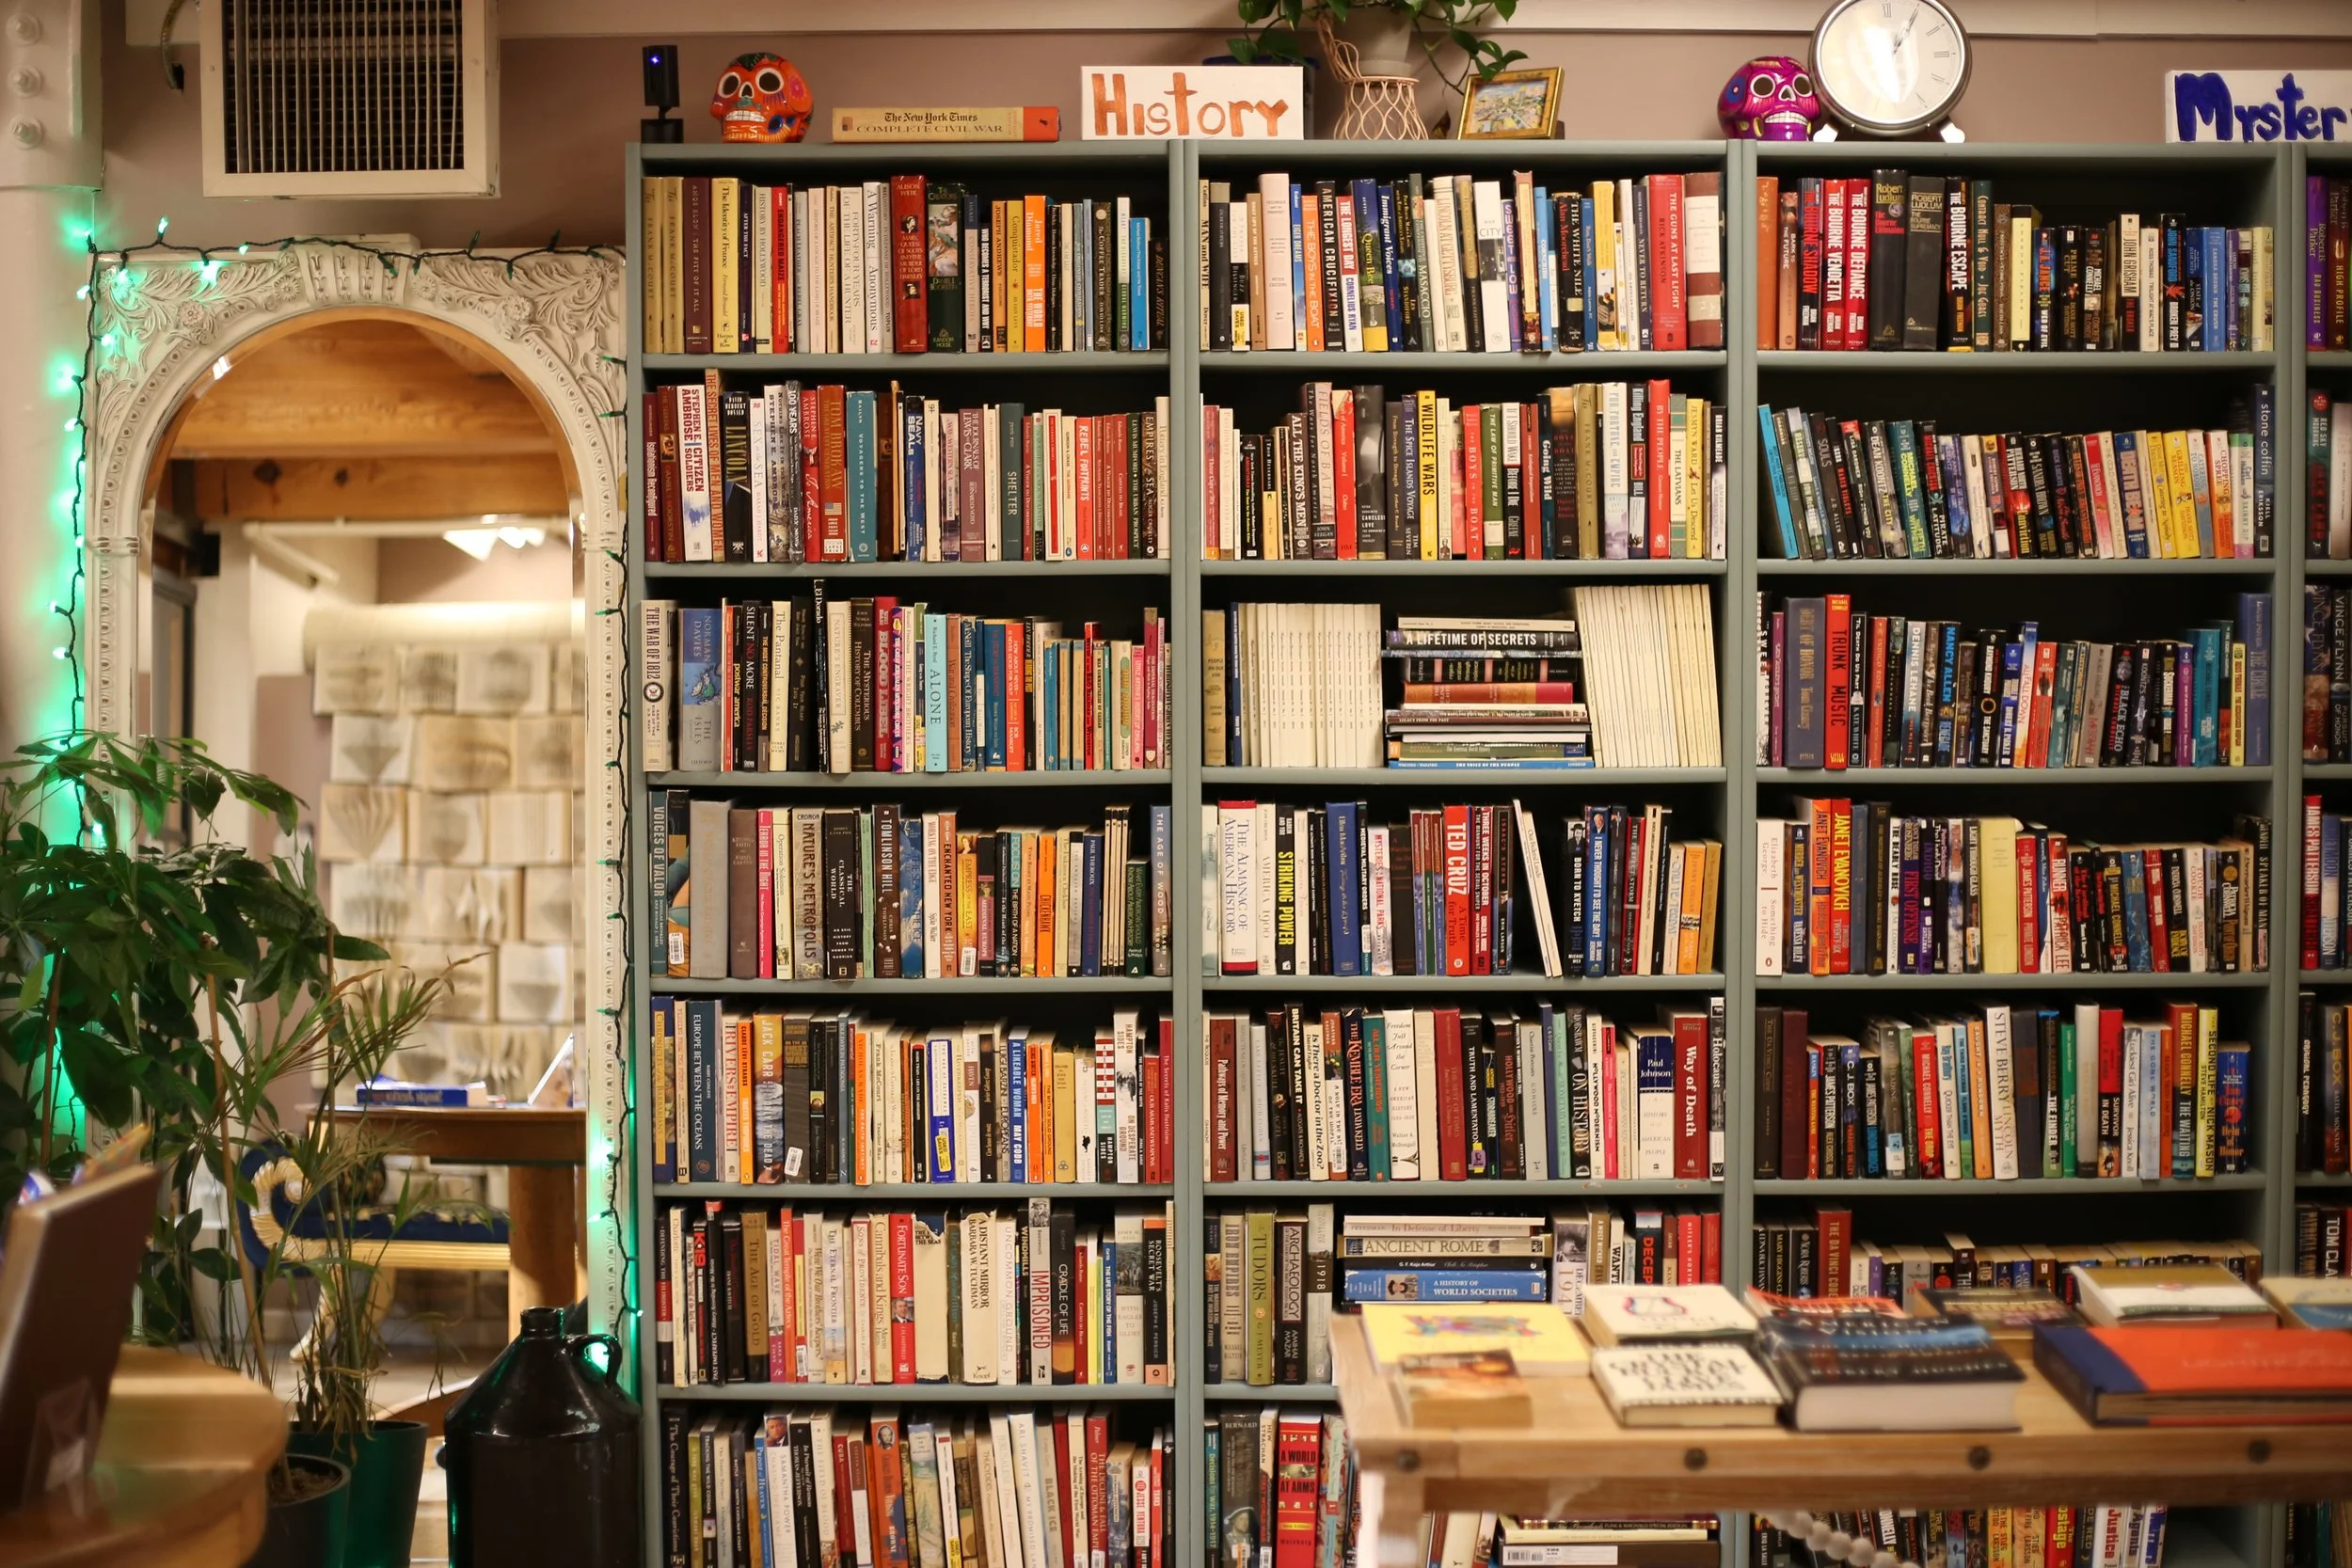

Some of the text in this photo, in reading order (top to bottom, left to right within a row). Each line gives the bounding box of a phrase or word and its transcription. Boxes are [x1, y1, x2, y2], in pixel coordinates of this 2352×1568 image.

[857, 125, 932, 134] COMPLETE
[934, 125, 971, 134] CIVIL
[884, 112, 977, 125] The New York Times
[2175, 72, 2352, 143] Myster
[1322, 188, 1339, 317] AMERICAN CRUCIFIXION
[1340, 201, 1355, 270] THE LONGEST DAY
[1380, 195, 1393, 275] Immigrant Voices
[1436, 198, 1456, 295] LINCOLN AT GETTYSBURG
[1570, 202, 1582, 296] THE WHITE NILE
[1671, 242, 1678, 255] AT
[1671, 256, 1679, 278] LAST
[1827, 192, 1844, 302] THE BOURNE VENDETTA
[1850, 193, 1867, 300] THE BOURNE DEFIANCE
[1949, 192, 1968, 291] THE BOURNE ESCAPE
[2123, 238, 2137, 293] JOHN GRISHAM
[1419, 264, 1431, 319] MASACCIO
[1672, 280, 1680, 309] LIGHT
[682, 388, 692, 441] AMBROSE
[691, 388, 702, 434] STEPHEN
[2260, 404, 2272, 476] stone coffin
[685, 448, 694, 493] SOLDIERS
[693, 447, 705, 492] CITIZEN
[706, 374, 724, 551] THE SECRET LIVES OF MEN AND WOMEN
[725, 426, 748, 483] LINCOLN
[1079, 425, 1090, 501] REBEL FOOTPRINTS
[1406, 419, 1417, 520] THE SPICE ISLANDS VOYAGE
[1421, 404, 1435, 496] WILDLIFE WARS
[1007, 470, 1018, 515] SHELTER
[646, 608, 660, 680] THE WAR OF 1812
[745, 606, 755, 689] SILENT NO MORE
[1406, 634, 1537, 646] A LIFETIME OF SECRETS
[1908, 626, 1920, 713] DENNIS LEHANE
[1942, 626, 1956, 703] NANCY ALLEN
[930, 670, 942, 725] ALONE
[1831, 628, 1848, 727] TRUNK MUSIC
[653, 806, 665, 897] VOICES OF VALOR
[881, 818, 893, 894] TOMLINSON HILL
[1225, 816, 1238, 935] AMERICAN HISTORY
[1238, 819, 1250, 931] THE ALMANAC OF
[1447, 822, 1468, 895] TED CRUZ
[1833, 813, 1851, 911] JANET EVANOVICH
[2053, 858, 2067, 893] RUNNER
[803, 823, 818, 958] NATURE'S METROPOLIS
[1279, 850, 1295, 945] STRIKING POWER
[2055, 916, 2070, 970] PATRICK LEE
[692, 1014, 702, 1049] EUROPE
[1291, 1008, 1303, 1104] BRITAIN CAN TAKE IT
[1994, 1012, 2010, 1103] STEVE BERRY
[2181, 1012, 2193, 1095] MICHAEL CONNELLY
[693, 1051, 702, 1092] BETWEEN
[1012, 1050, 1022, 1085] LIKEABLE
[1012, 1087, 1023, 1117] WOMAN
[1684, 1046, 1697, 1137] Way of Death
[694, 1114, 703, 1149] OCEANS
[1013, 1125, 1023, 1143] MAY
[1572, 1072, 1590, 1154] ON HISTORY
[2047, 1095, 2058, 1146] THE FINDER
[1014, 1144, 1023, 1164] COBB
[897, 1225, 909, 1294] FORTUNATE SON
[1251, 1234, 1267, 1301] TUDORS
[1289, 1227, 1300, 1319] ARCHAEOLOGY
[1317, 1264, 1327, 1291] 1918
[1364, 1240, 1485, 1253] ANCIENT ROME
[1031, 1270, 1051, 1350] IMPRISONED
[1059, 1263, 1069, 1336] CRADLE OF LIFE
[1045, 1478, 1057, 1532] BLACK ICE
[2104, 1509, 2121, 1559] Justice
